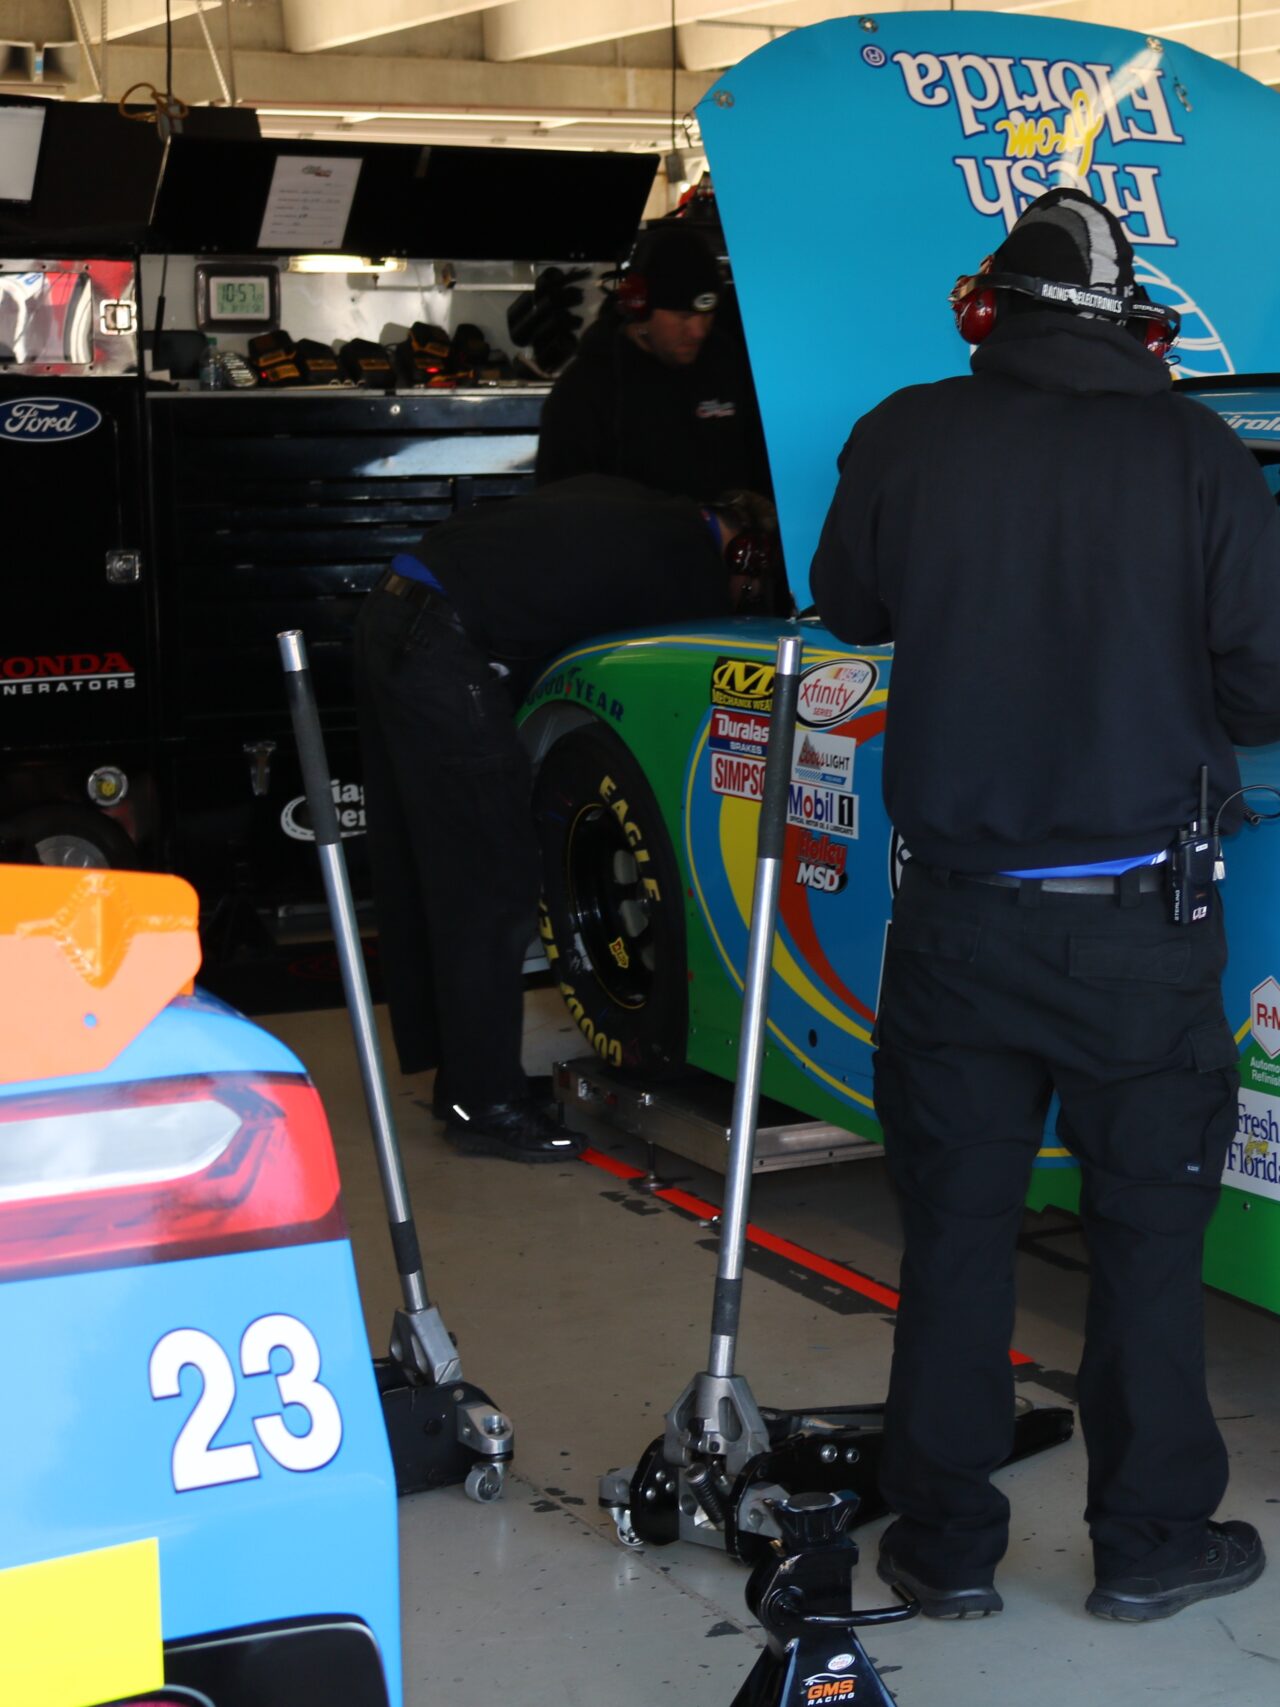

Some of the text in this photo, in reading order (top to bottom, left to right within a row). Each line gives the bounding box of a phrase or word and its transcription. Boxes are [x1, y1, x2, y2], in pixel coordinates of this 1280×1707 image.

[893, 51, 1185, 144] Florida
[994, 87, 1105, 177] from
[1041, 283, 1123, 314] RACING ELECTRONICS
[4, 403, 78, 433] Ford
[0, 652, 136, 679] ONDA
[3, 678, 136, 696] NERATORS
[800, 679, 855, 712] xfinity
[753, 698, 773, 712] WEA
[812, 707, 833, 718] SERIES
[715, 713, 770, 742] Duralas
[729, 741, 763, 755] BRAKES
[825, 753, 850, 771] LIGHT
[714, 757, 767, 795] SIMPSO
[787, 784, 833, 823] Mobil
[599, 775, 661, 901] EAGLE
[796, 862, 840, 892] MSD
[1237, 1103, 1280, 1144] Fresh
[148, 1311, 344, 1494] 23
[807, 1679, 855, 1700] GMS
[807, 1692, 856, 1706] RACING
